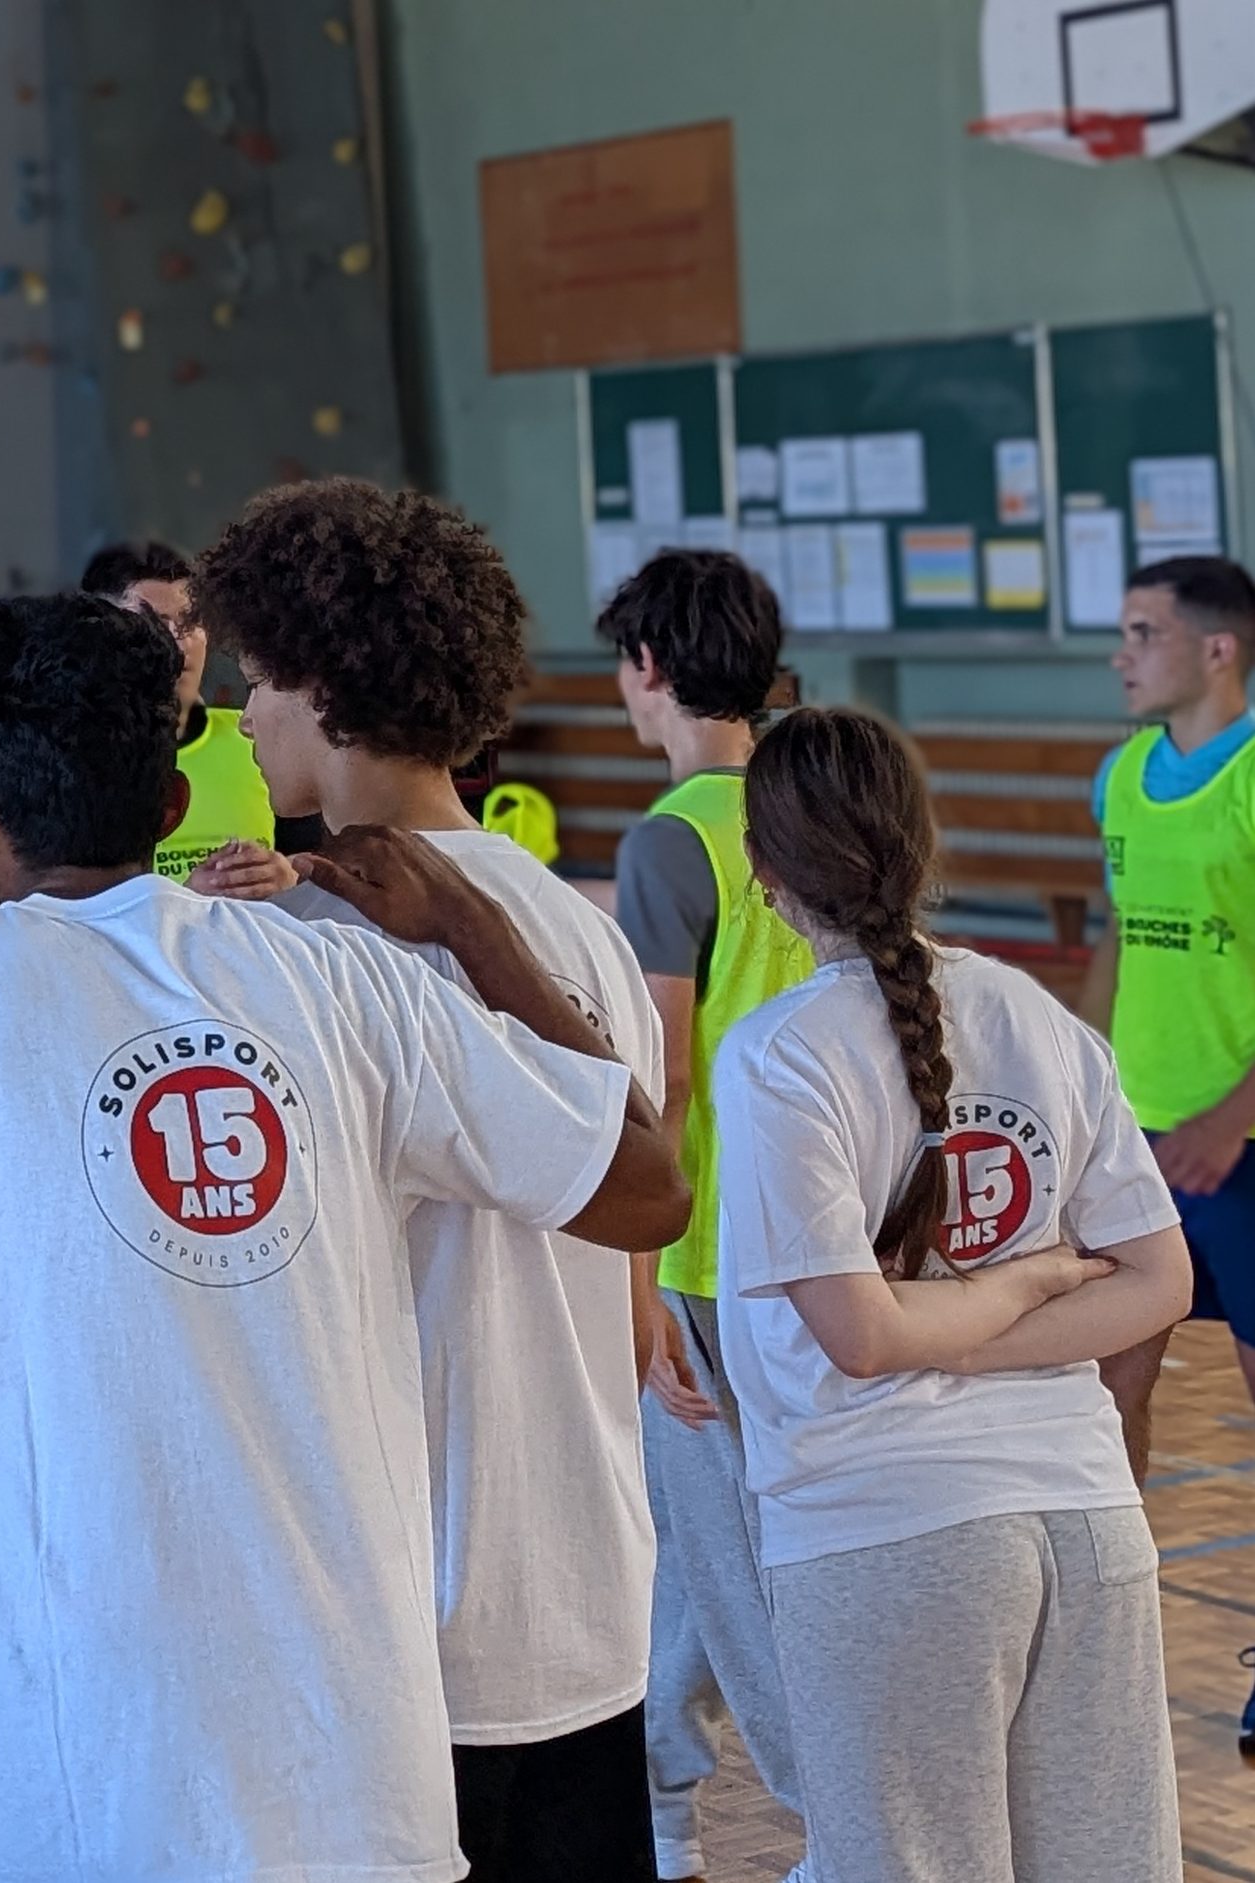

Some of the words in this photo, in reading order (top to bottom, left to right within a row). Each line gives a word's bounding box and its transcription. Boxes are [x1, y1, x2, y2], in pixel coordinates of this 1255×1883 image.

[156, 847, 219, 863] BOUCH
[158, 863, 182, 876] DU
[99, 1034, 298, 1117] SOLISPORT
[148, 1087, 268, 1182] 15
[954, 1104, 1052, 1158] SPORT
[181, 1184, 256, 1218] ANS
[149, 1230, 229, 1268] DEPUIS
[245, 1227, 290, 1263] 2010
[949, 1219, 998, 1253] ANS
